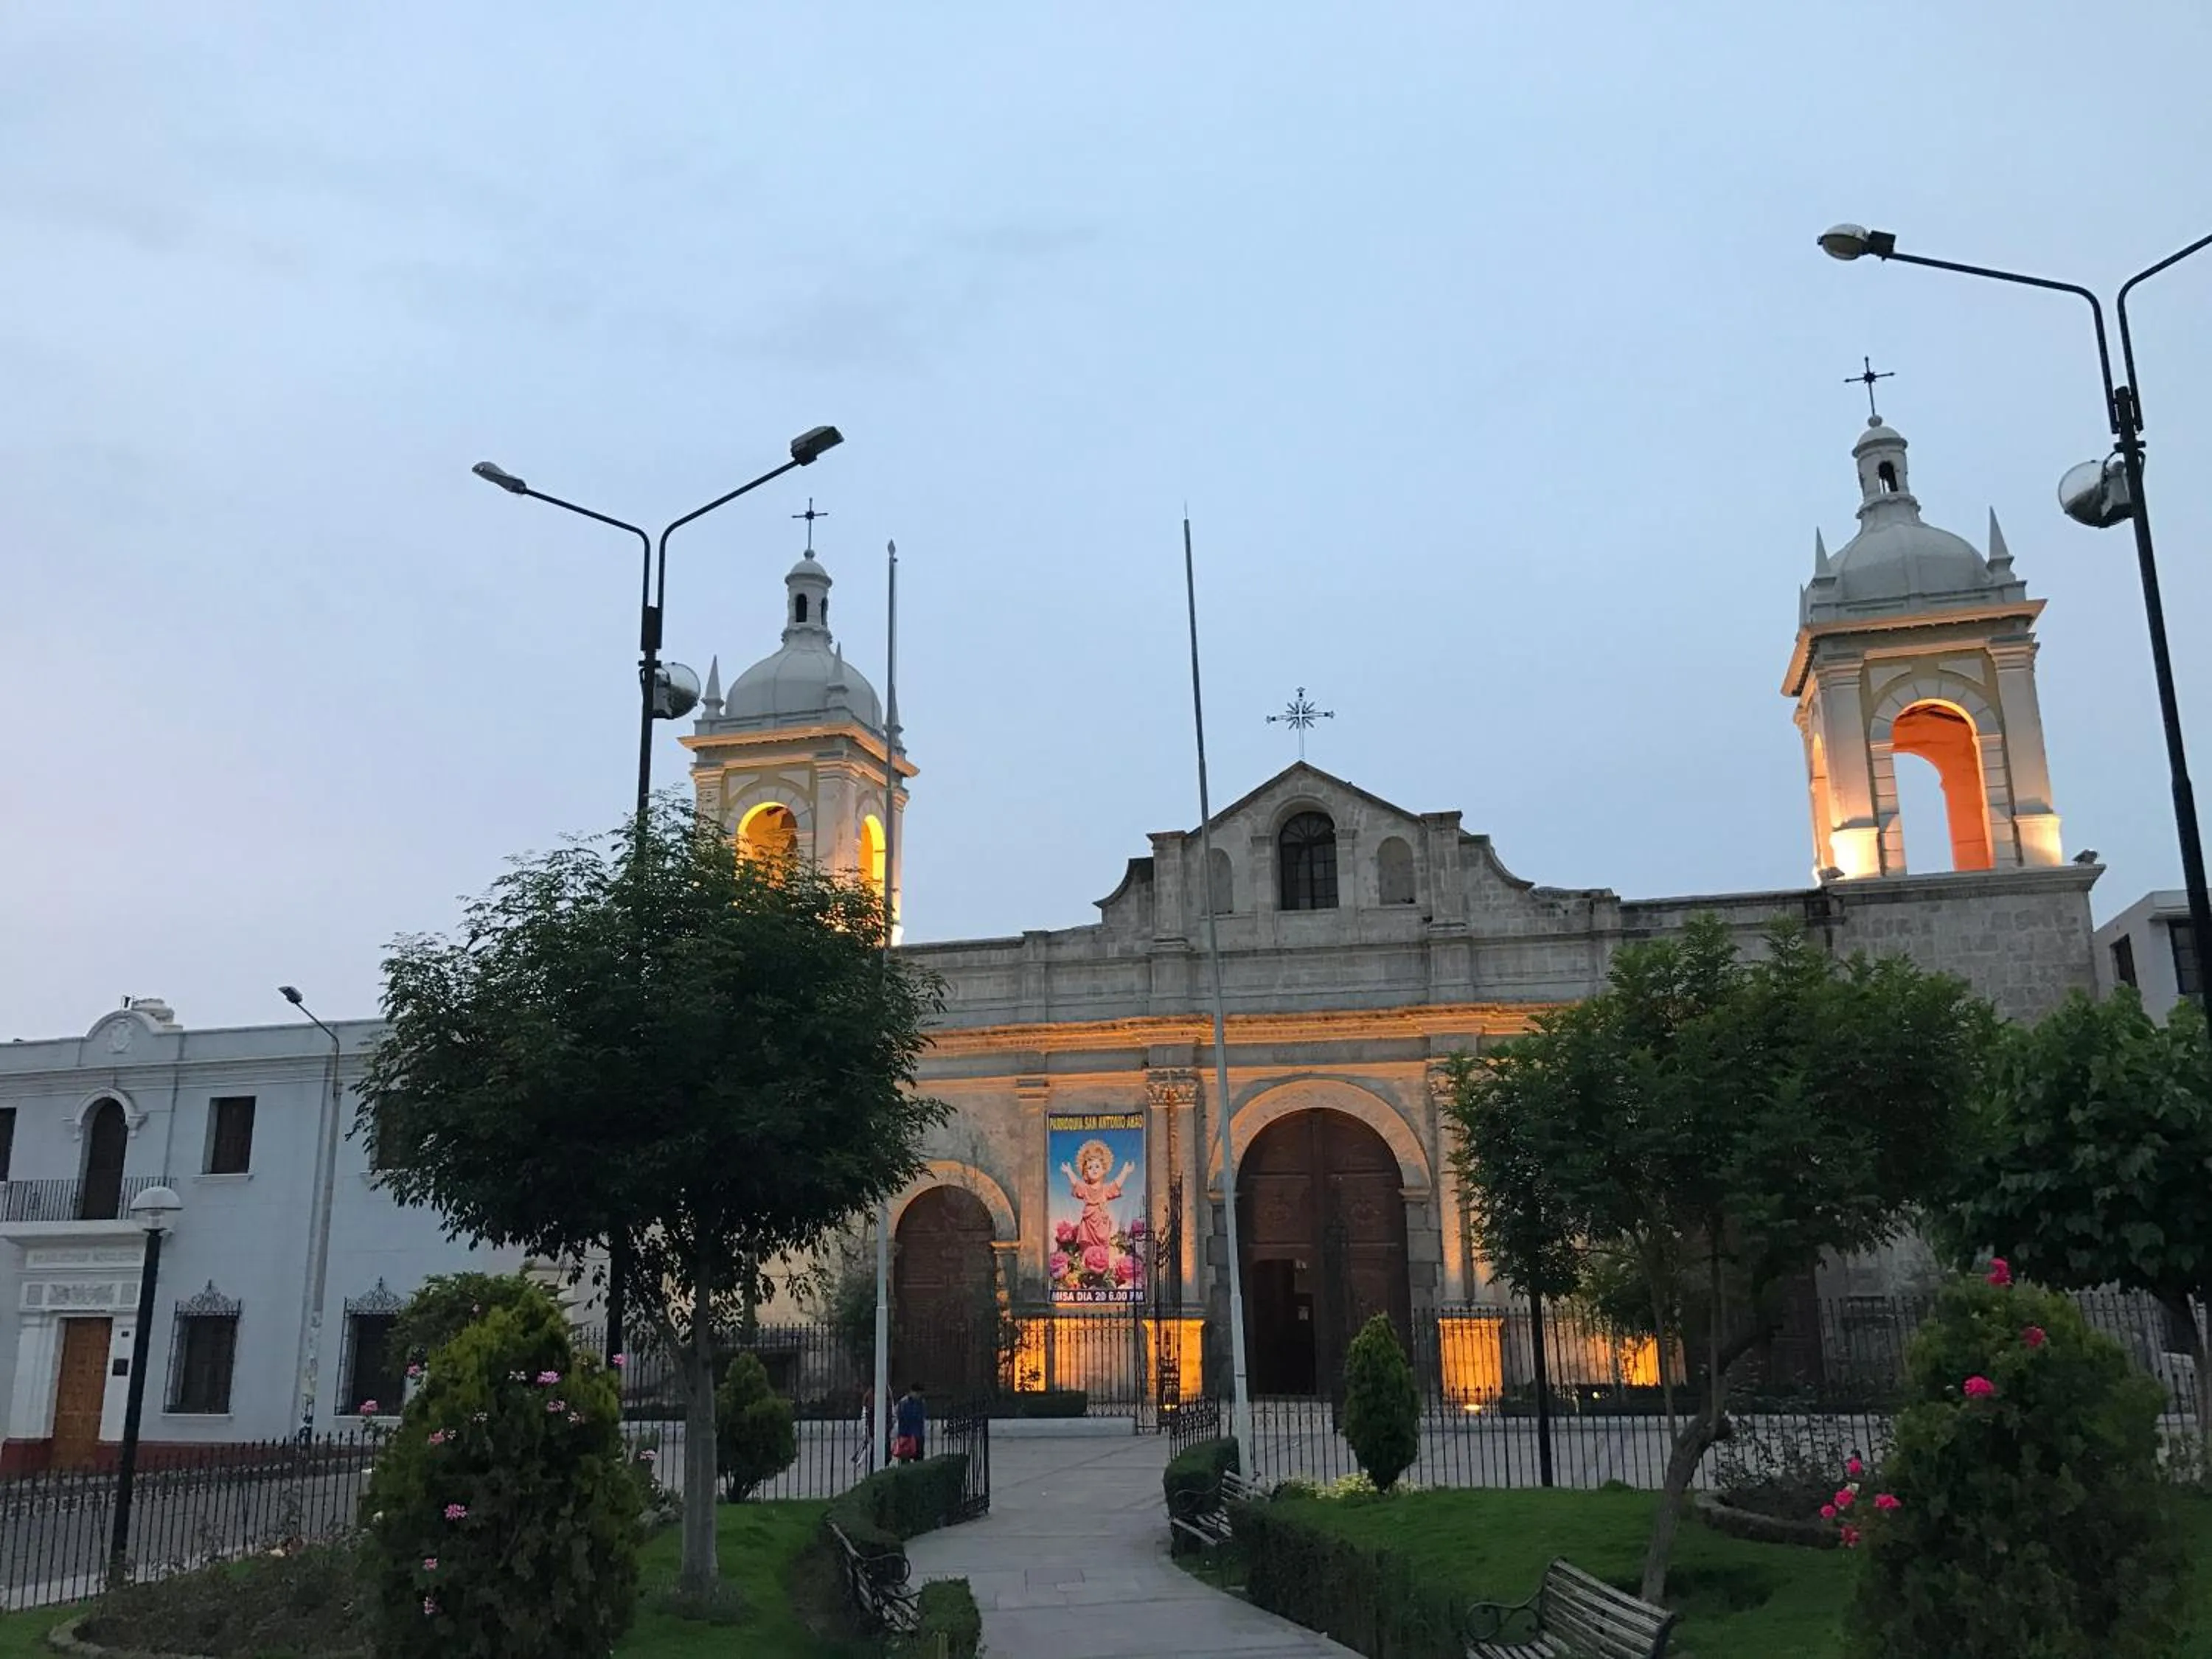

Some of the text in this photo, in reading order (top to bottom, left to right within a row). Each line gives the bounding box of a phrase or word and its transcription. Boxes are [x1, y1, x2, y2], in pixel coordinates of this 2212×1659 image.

[1051, 1291, 1074, 1301] MISA
[1077, 1291, 1093, 1301] DIA
[1095, 1291, 1107, 1301] 20
[1130, 1290, 1144, 1301] PM
